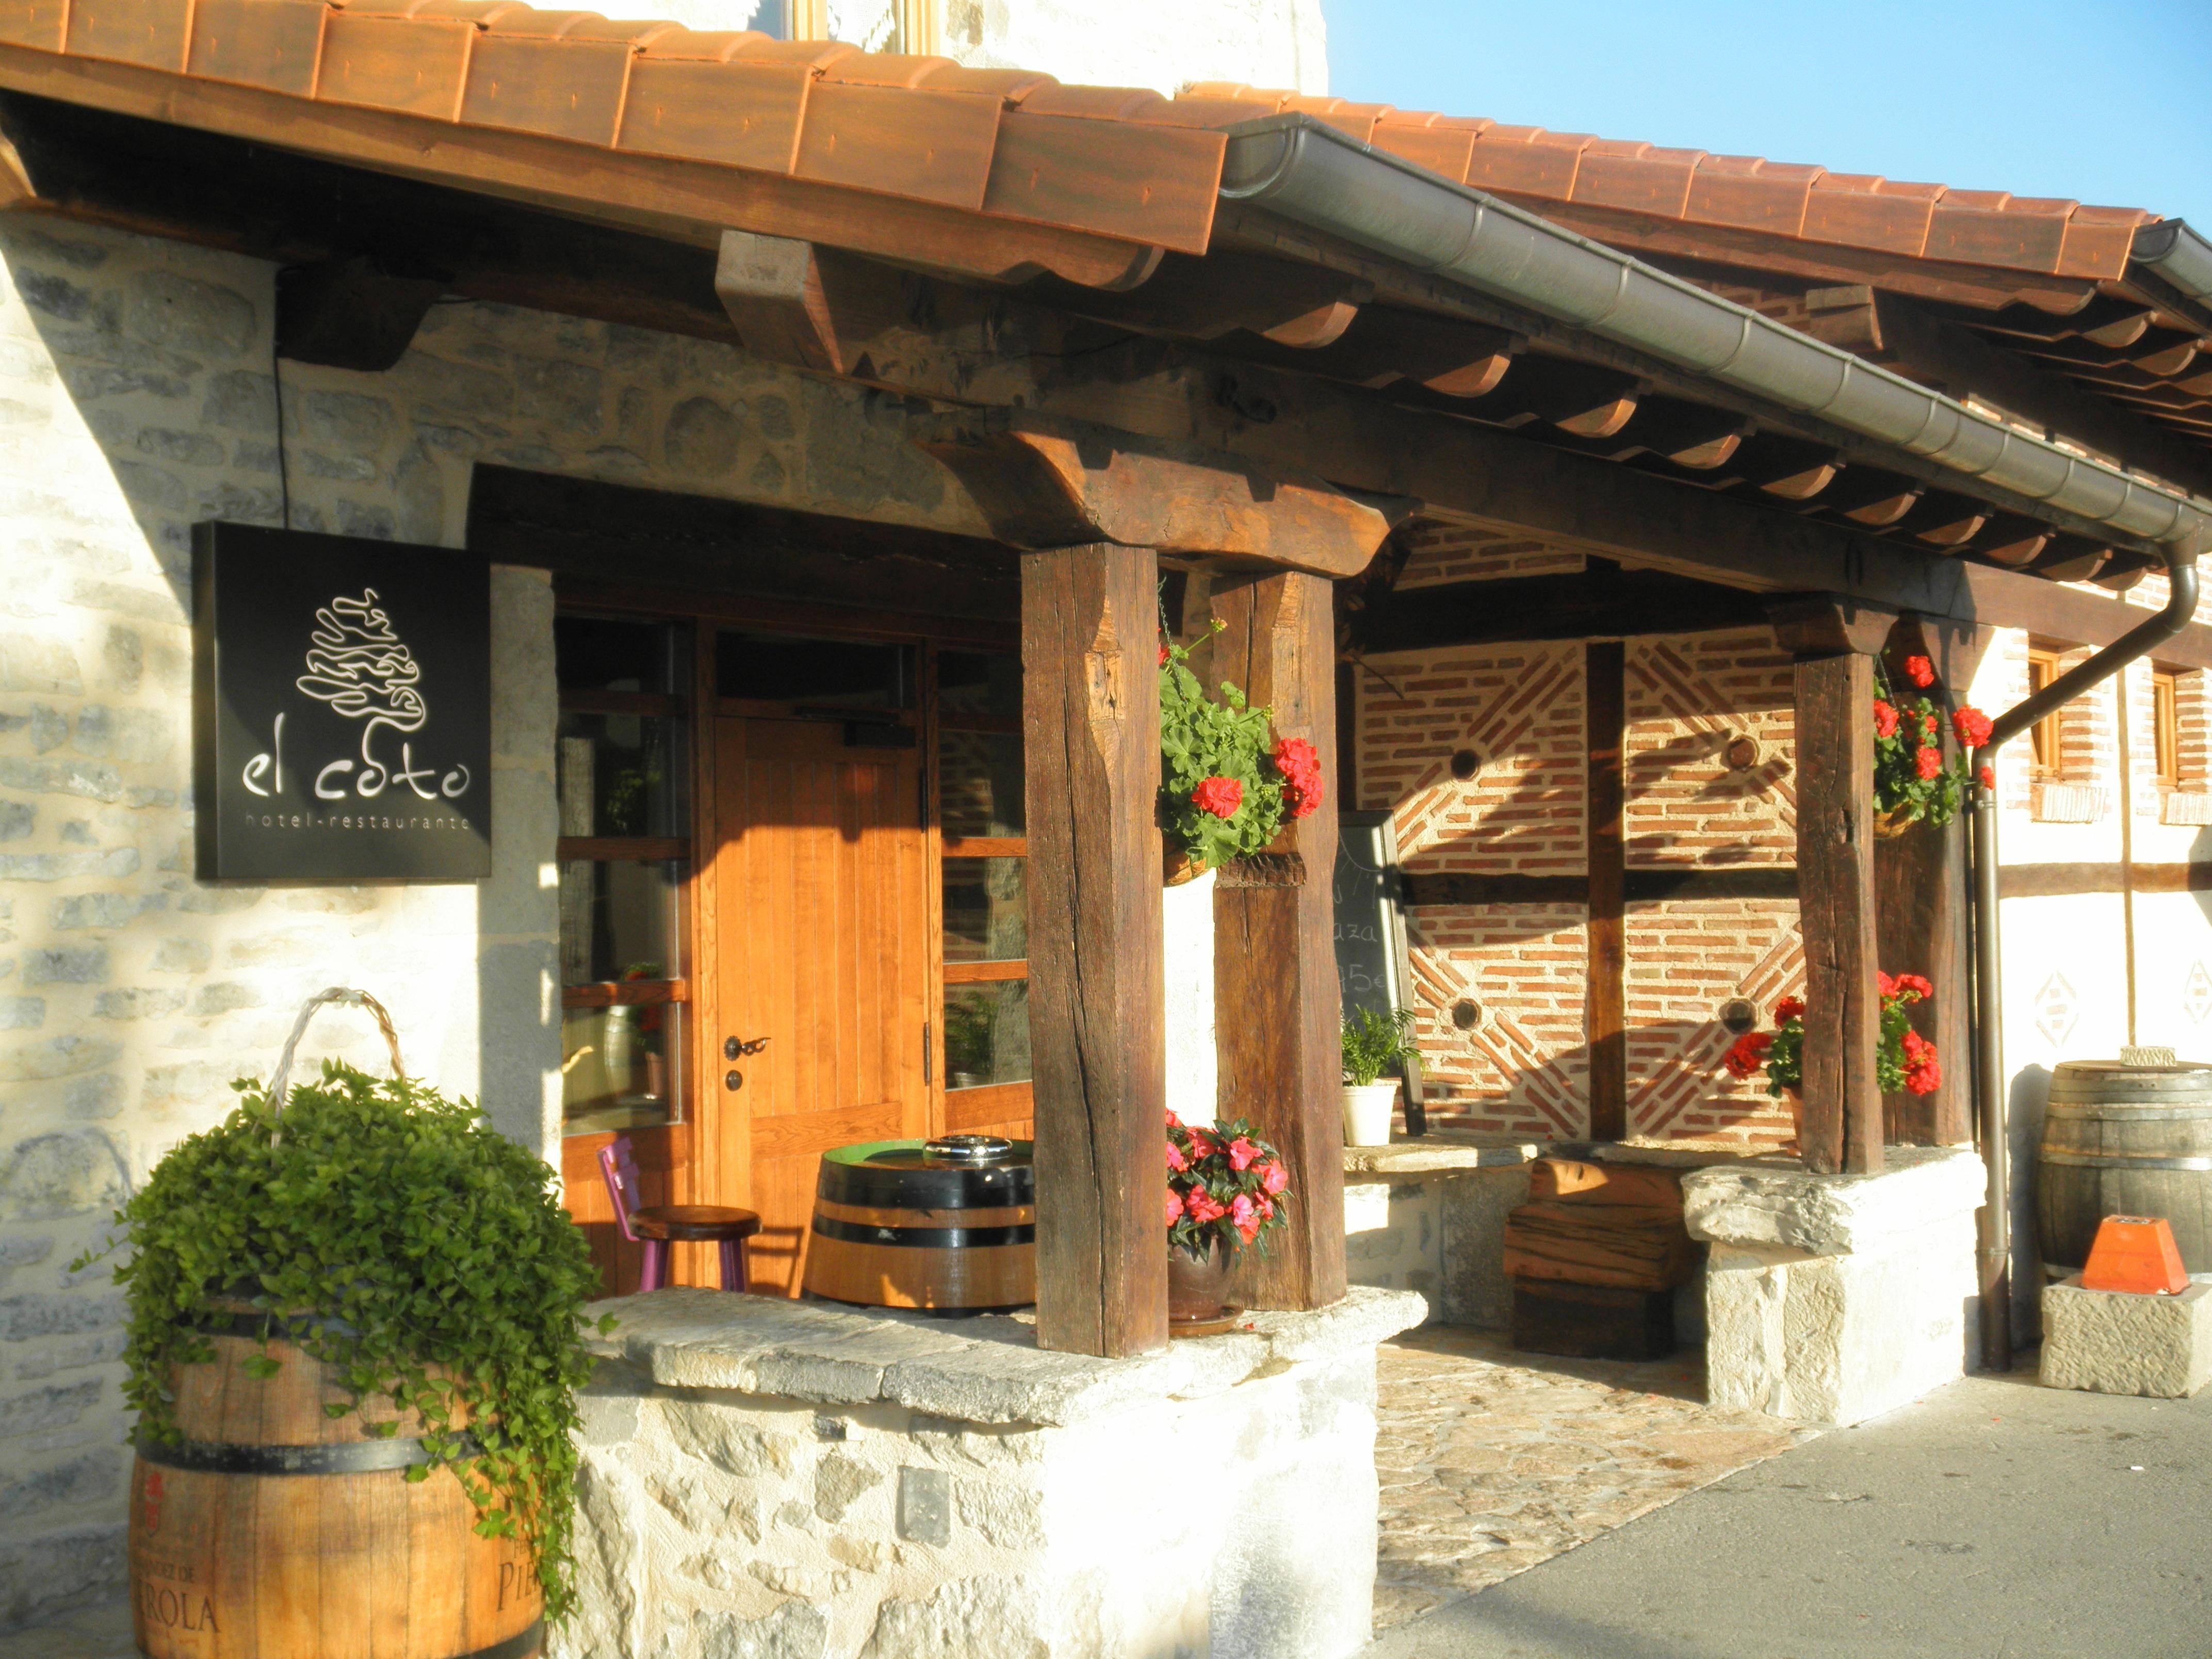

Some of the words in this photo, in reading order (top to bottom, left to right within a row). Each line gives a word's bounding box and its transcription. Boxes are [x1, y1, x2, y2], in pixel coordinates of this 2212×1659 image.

[242, 712, 285, 797] el
[315, 742, 469, 799] coto
[245, 812, 469, 830] hotel-restaurante
